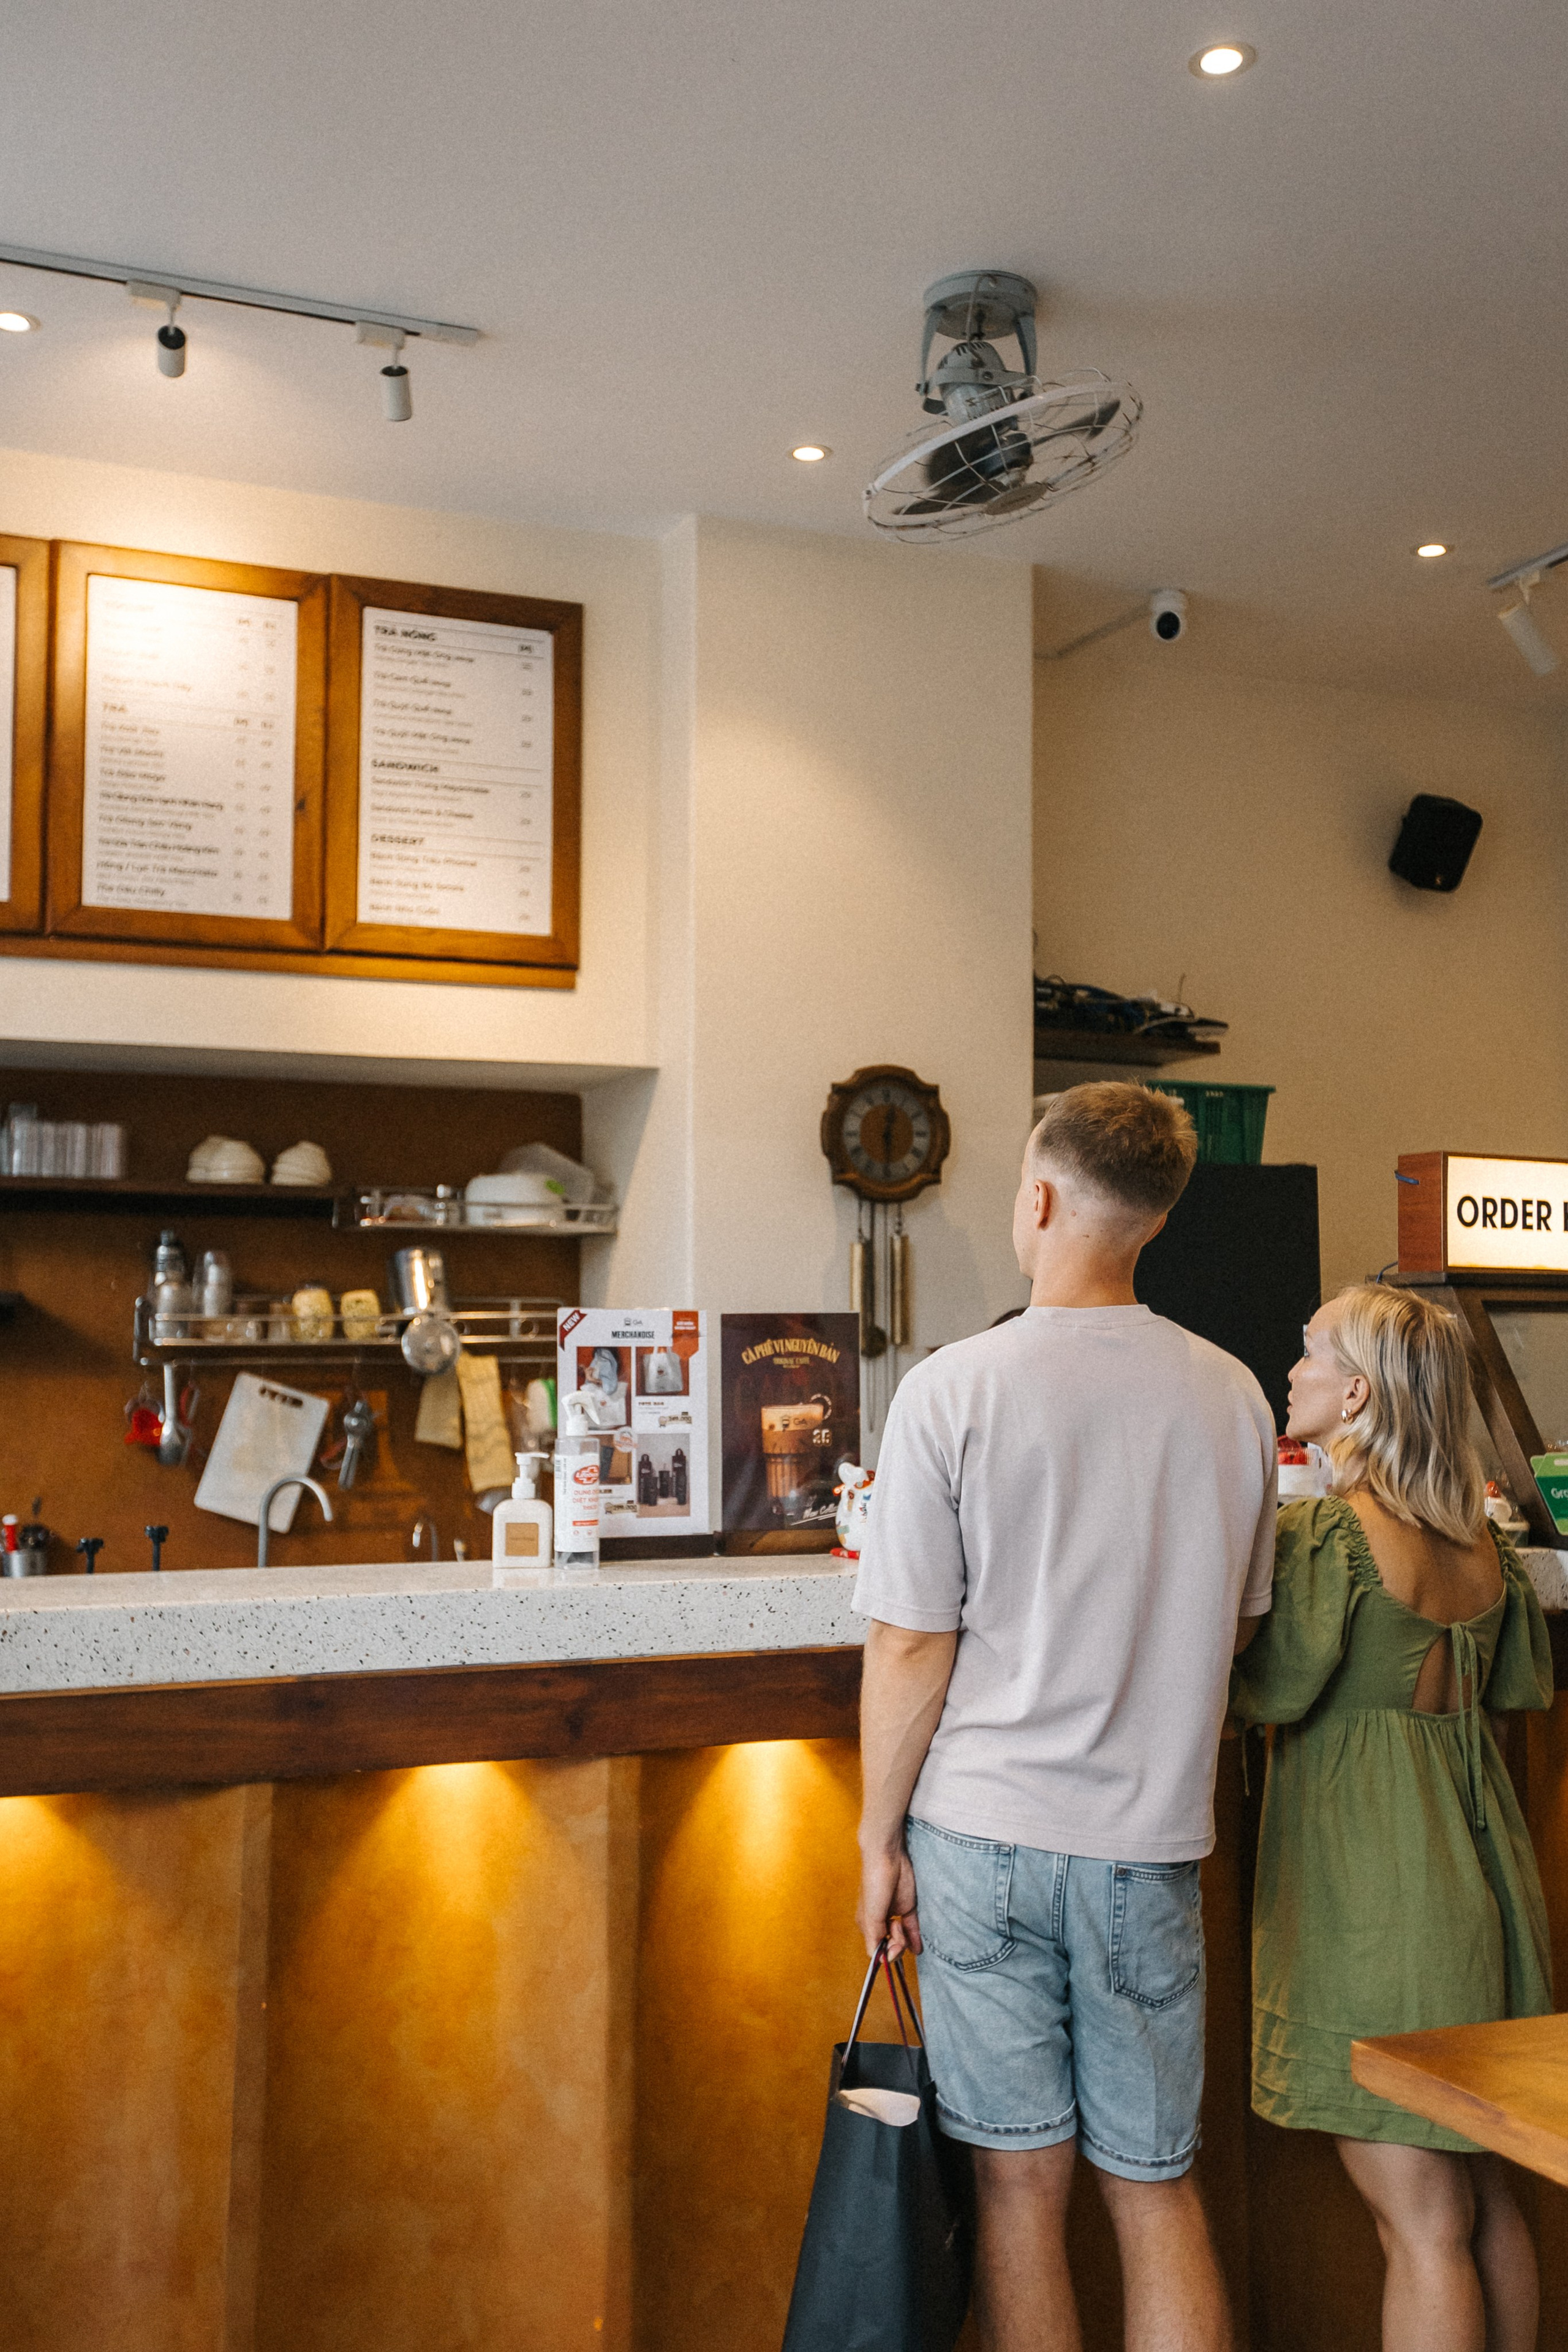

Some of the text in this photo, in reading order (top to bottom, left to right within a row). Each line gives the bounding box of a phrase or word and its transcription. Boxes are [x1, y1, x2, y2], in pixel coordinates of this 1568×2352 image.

[1457, 1195, 1552, 1232] ORDER
[562, 1313, 581, 1332] NEW
[611, 1331, 655, 1340] MERCHANDISE
